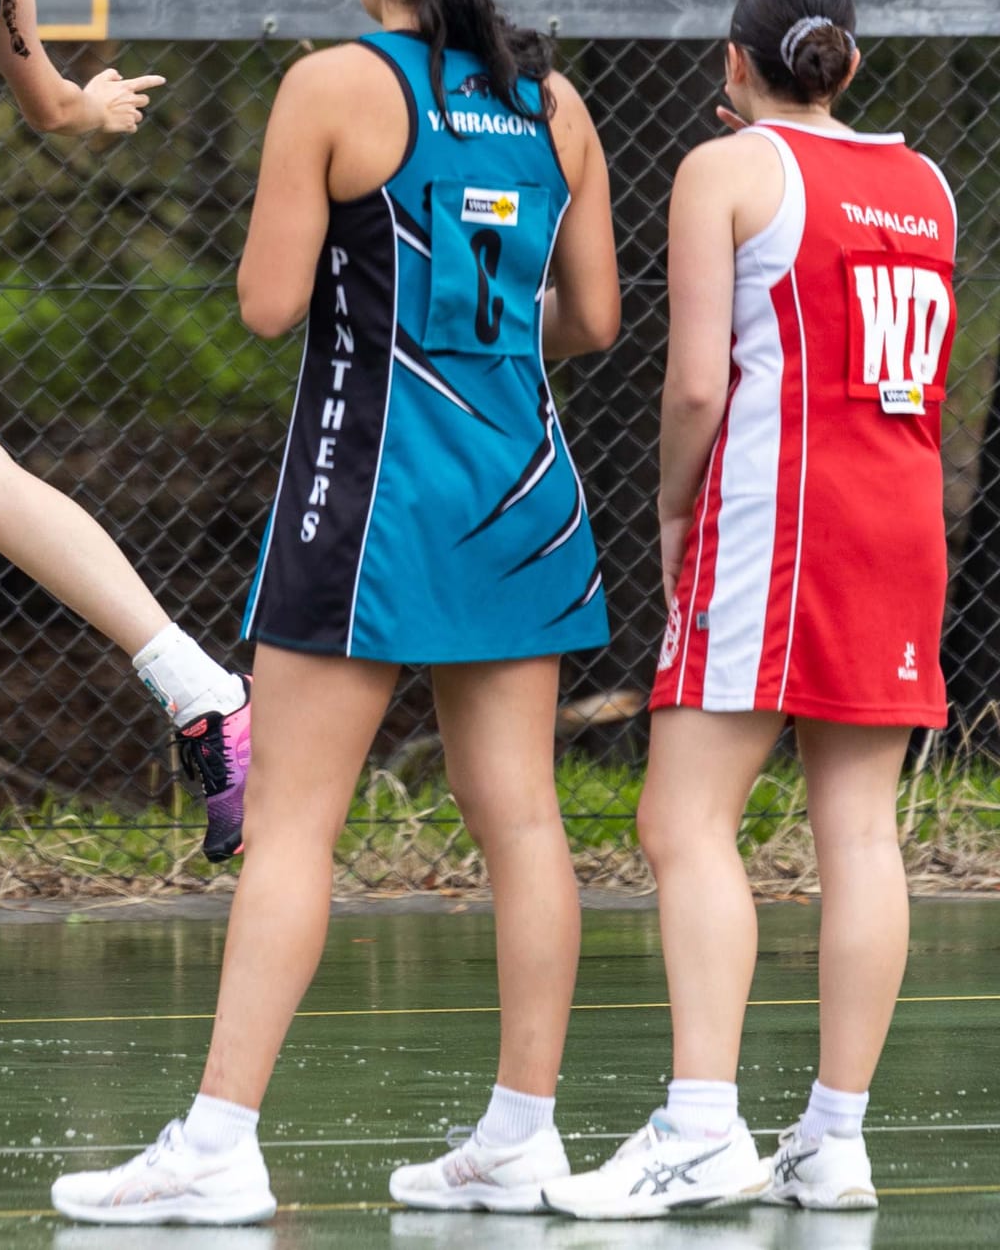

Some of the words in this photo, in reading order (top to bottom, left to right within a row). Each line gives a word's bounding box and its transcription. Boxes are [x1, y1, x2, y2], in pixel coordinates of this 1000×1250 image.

[841, 202, 939, 240] TRAFALGAR
[853, 265, 949, 385] WD
[300, 246, 355, 543] PANTHERS
